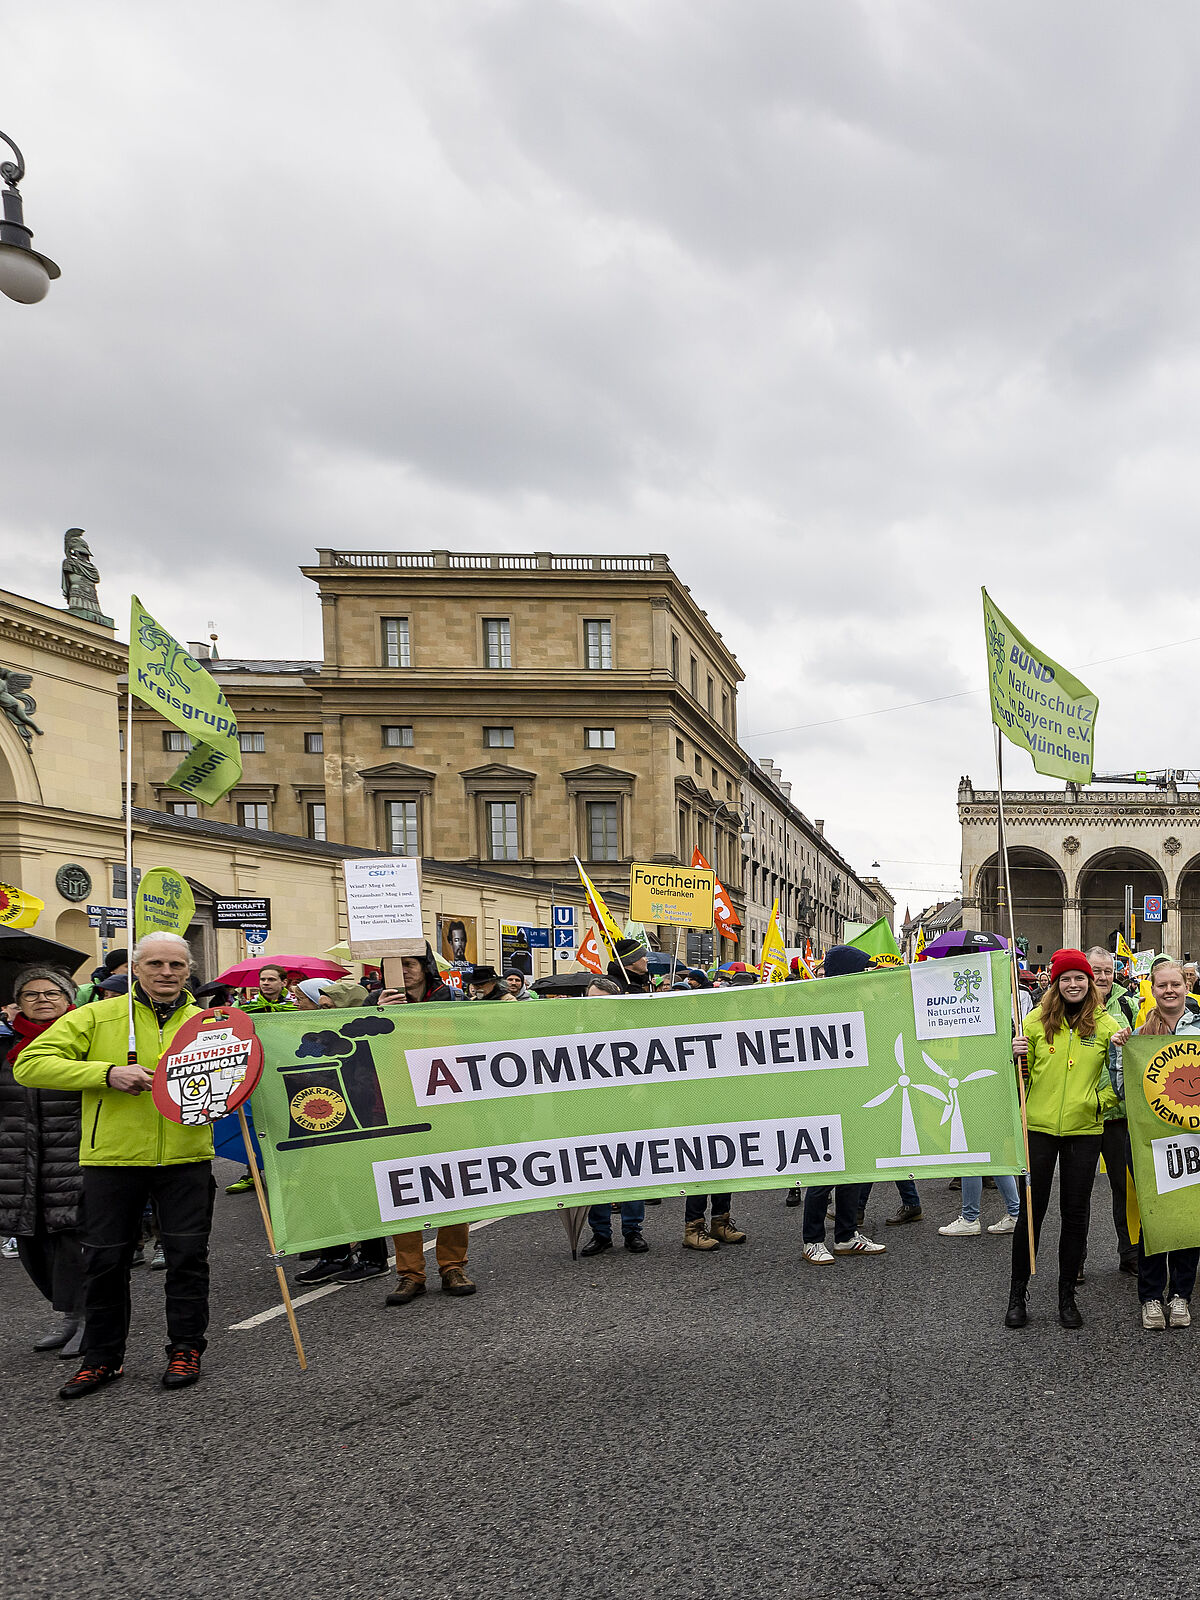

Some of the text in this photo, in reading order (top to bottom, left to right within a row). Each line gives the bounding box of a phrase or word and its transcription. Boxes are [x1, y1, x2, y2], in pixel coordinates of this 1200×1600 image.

[1010, 645, 1055, 683] BUND
[138, 668, 240, 741] Kreisgrupp
[1009, 670, 1093, 722] Naturschutz
[1009, 692, 1016, 712] in
[1018, 701, 1062, 734] Bayern
[1068, 727, 1090, 743] e.V.
[1026, 731, 1089, 765] München
[635, 870, 711, 890] Forchheim
[144, 894, 164, 905] BUND
[651, 887, 694, 899] Oberfranken
[558, 909, 569, 923] U
[927, 996, 957, 1006] BUND
[928, 1006, 980, 1017] Naturschutz
[938, 1018, 966, 1026] Bayern
[171, 1042, 249, 1066] ABSCHALTEN!
[426, 1022, 854, 1096] ATOMKRAFT NEIN!
[171, 1055, 245, 1077] ATOMKRAFT
[293, 1088, 343, 1108] ATOMKRAFT?
[295, 1111, 345, 1129] NEIN DANKE
[1151, 1098, 1184, 1126] NEIN
[389, 1126, 833, 1208] ENERGIEWENDE JA!
